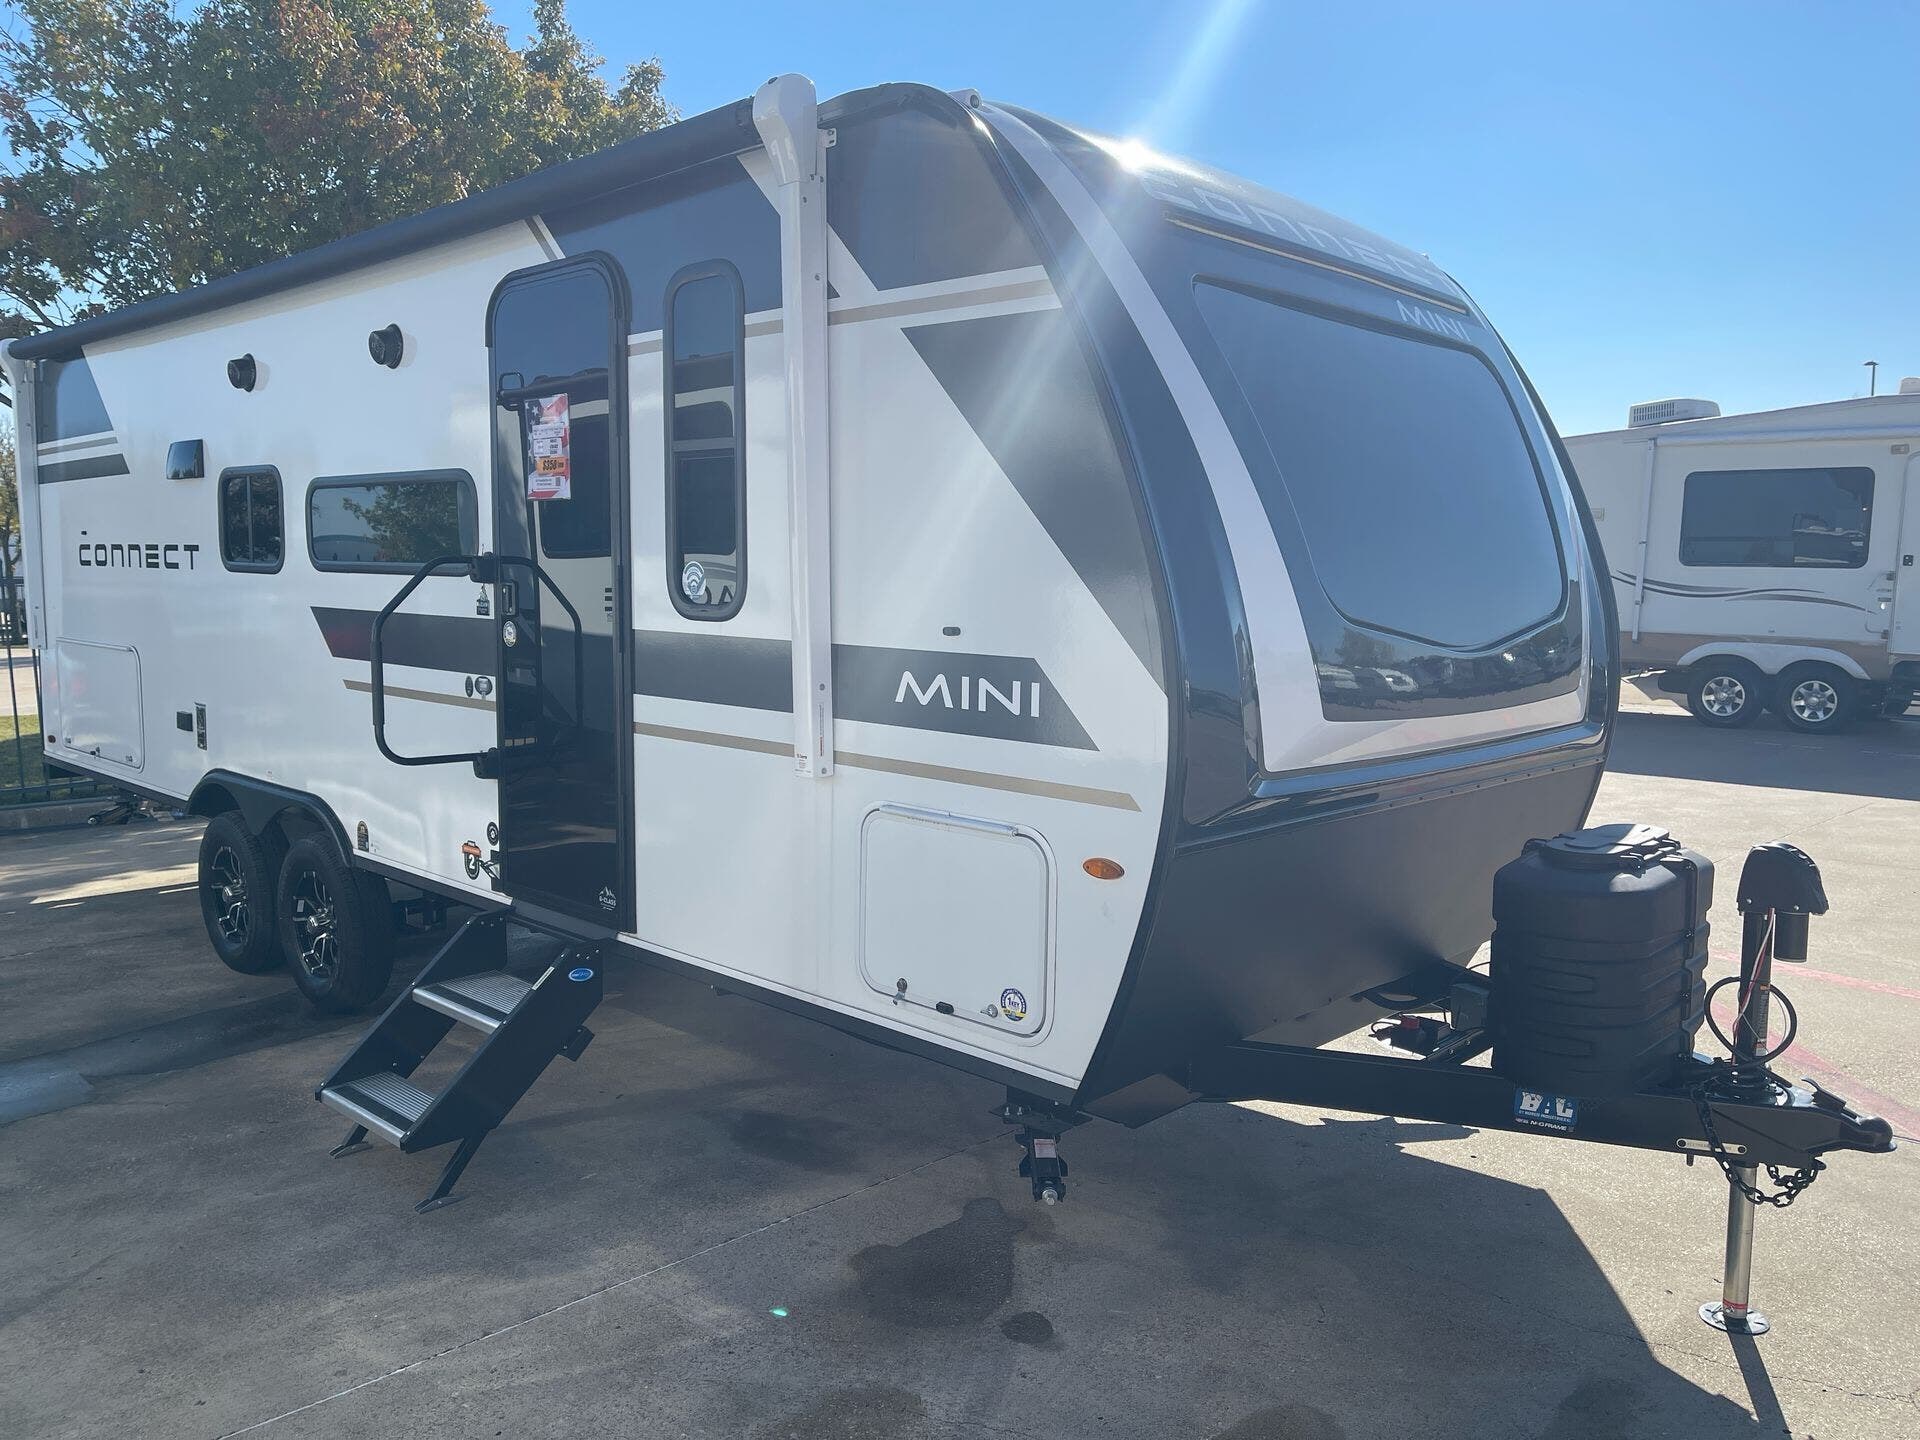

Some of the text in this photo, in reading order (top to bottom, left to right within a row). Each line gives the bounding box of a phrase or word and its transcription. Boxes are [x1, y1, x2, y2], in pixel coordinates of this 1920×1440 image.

[1396, 299, 1471, 341] MINI
[79, 543, 200, 570] CONNECT
[894, 670, 1040, 718] MINI
